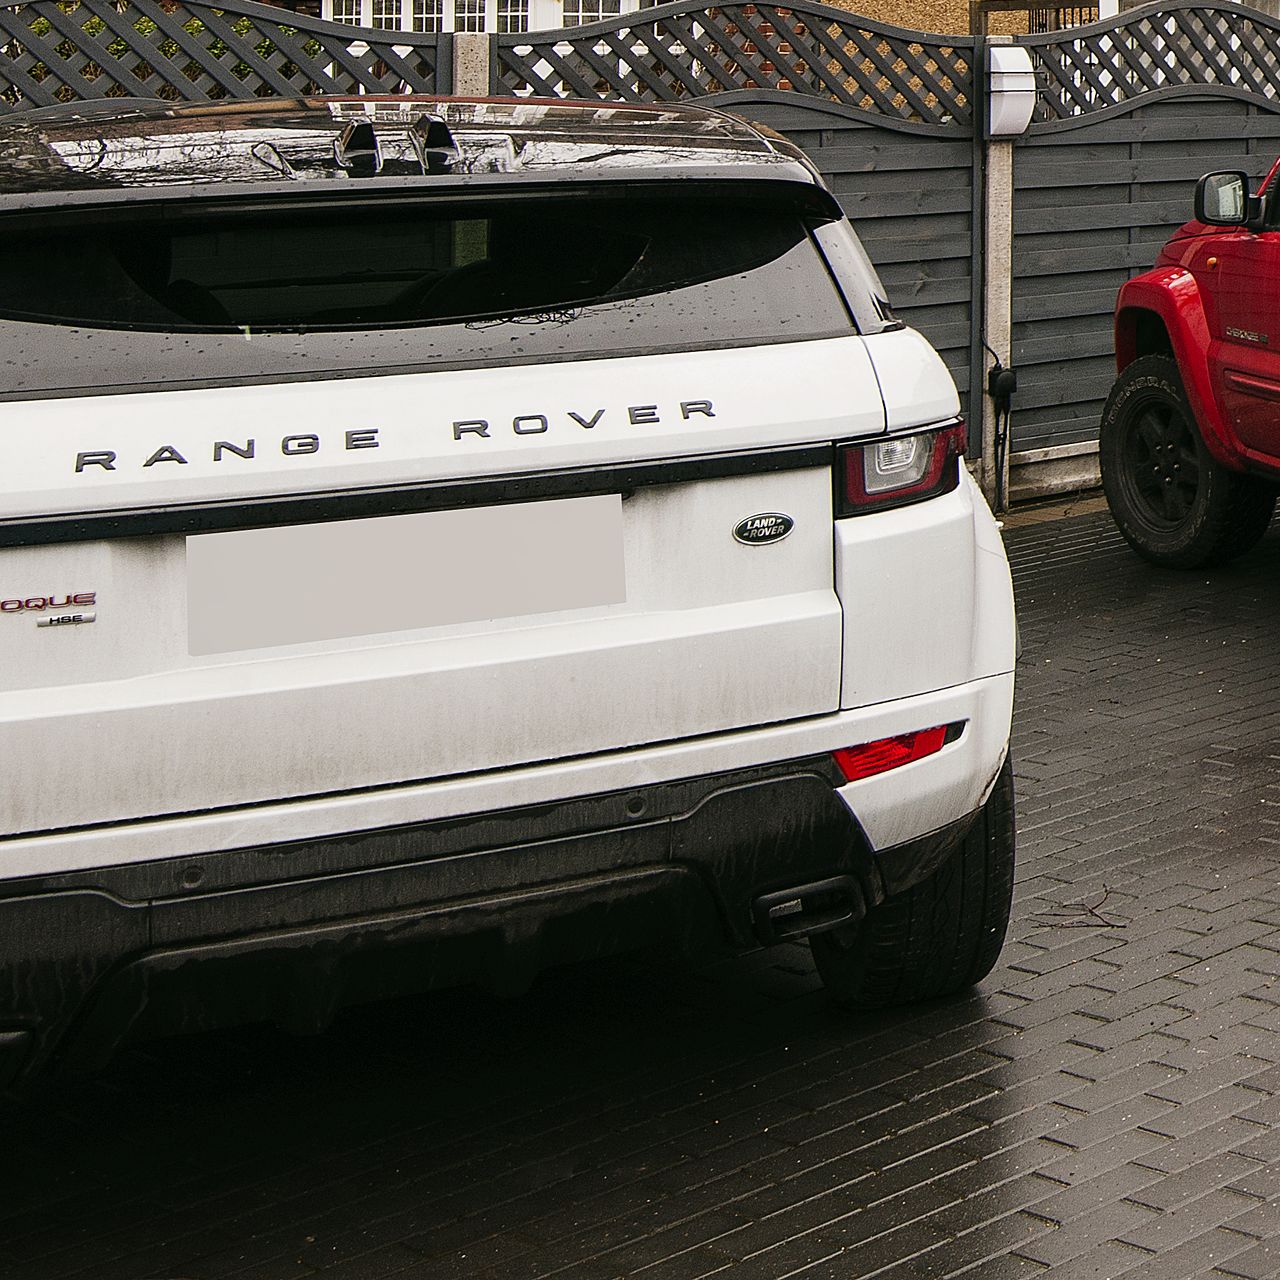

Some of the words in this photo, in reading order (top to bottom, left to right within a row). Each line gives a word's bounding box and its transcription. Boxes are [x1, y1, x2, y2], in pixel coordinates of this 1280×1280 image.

[75, 428, 379, 472] RANGE
[453, 399, 717, 441] ROVER
[747, 518, 775, 529] LAND
[750, 525, 785, 538] ROVER
[0, 592, 97, 612] OQUE
[49, 615, 84, 624] HSE
